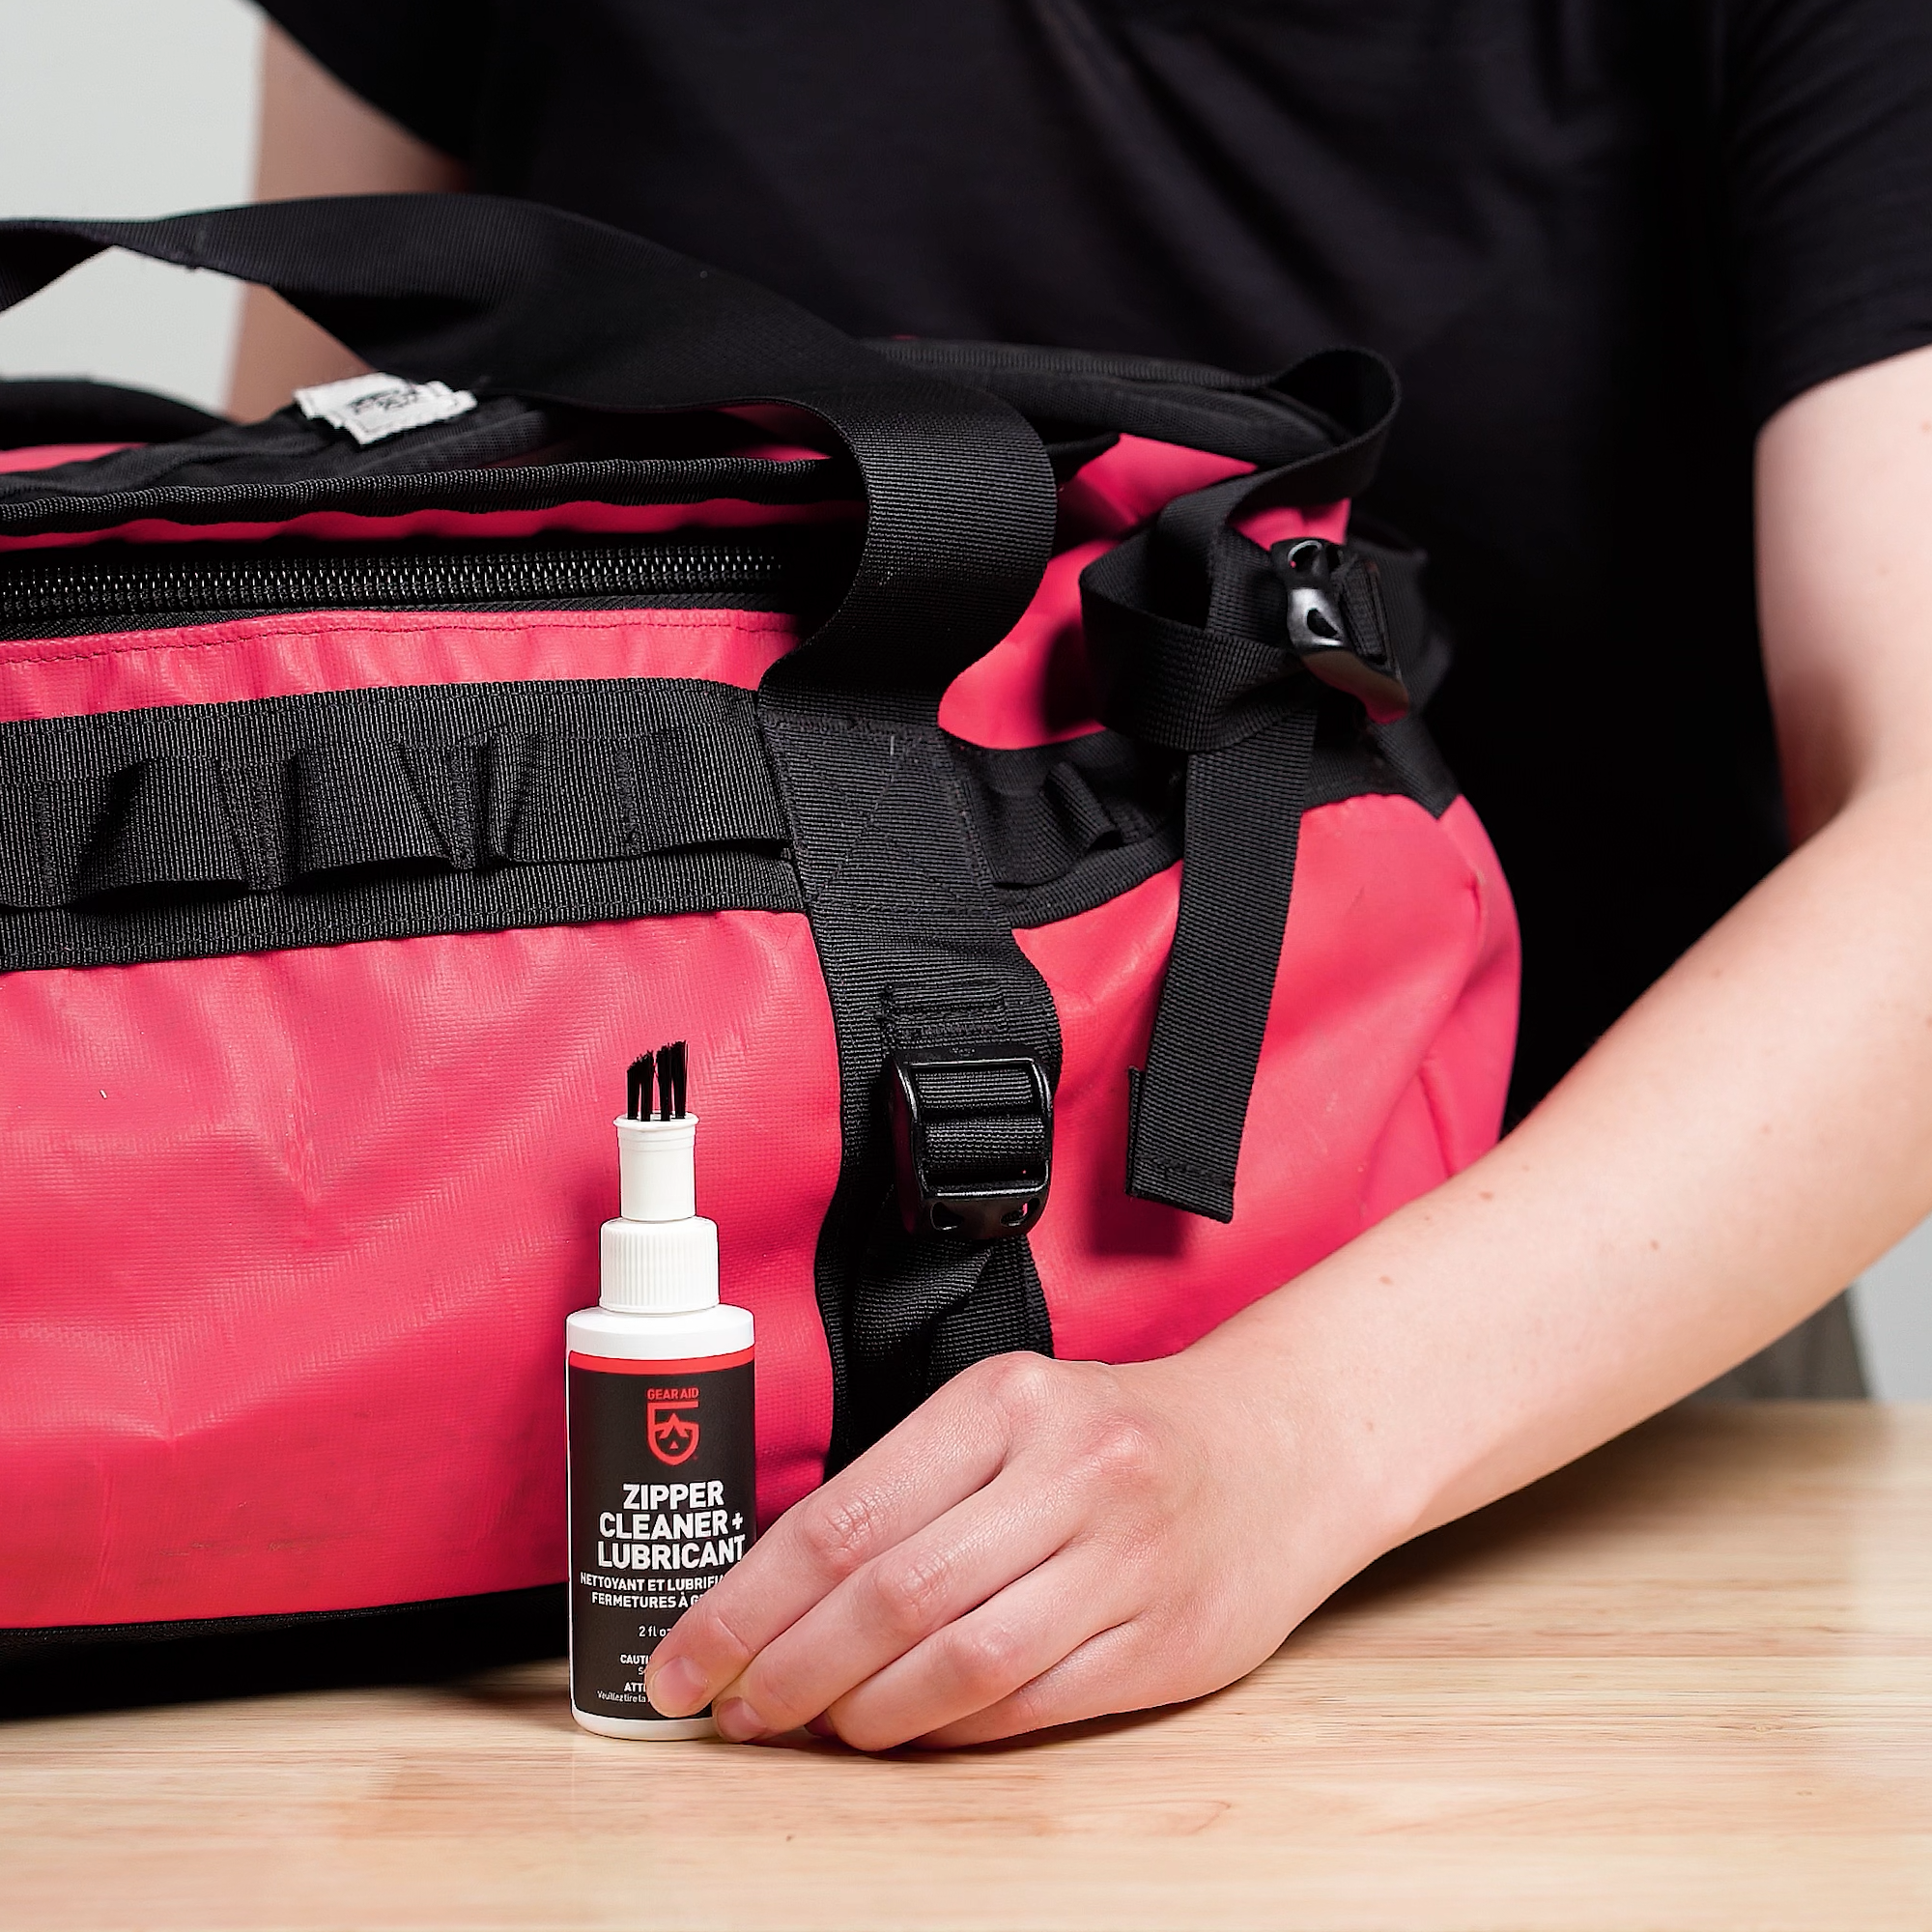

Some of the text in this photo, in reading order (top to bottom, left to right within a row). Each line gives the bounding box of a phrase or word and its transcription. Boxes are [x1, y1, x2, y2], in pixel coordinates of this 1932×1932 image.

[647, 1387, 699, 1400] GEAR AID
[623, 1481, 724, 1510] ZIPPER
[599, 1510, 728, 1540] CLEANER
[597, 1534, 746, 1570] LUBRICANT
[581, 1572, 724, 1592] NETTOYANT ET LUBRIFI
[591, 1591, 676, 1608] FERMETURES
[678, 1592, 689, 1607] À
[639, 1626, 646, 1637] 2
[648, 1626, 657, 1637] fl
[620, 1654, 649, 1664] CAUTI
